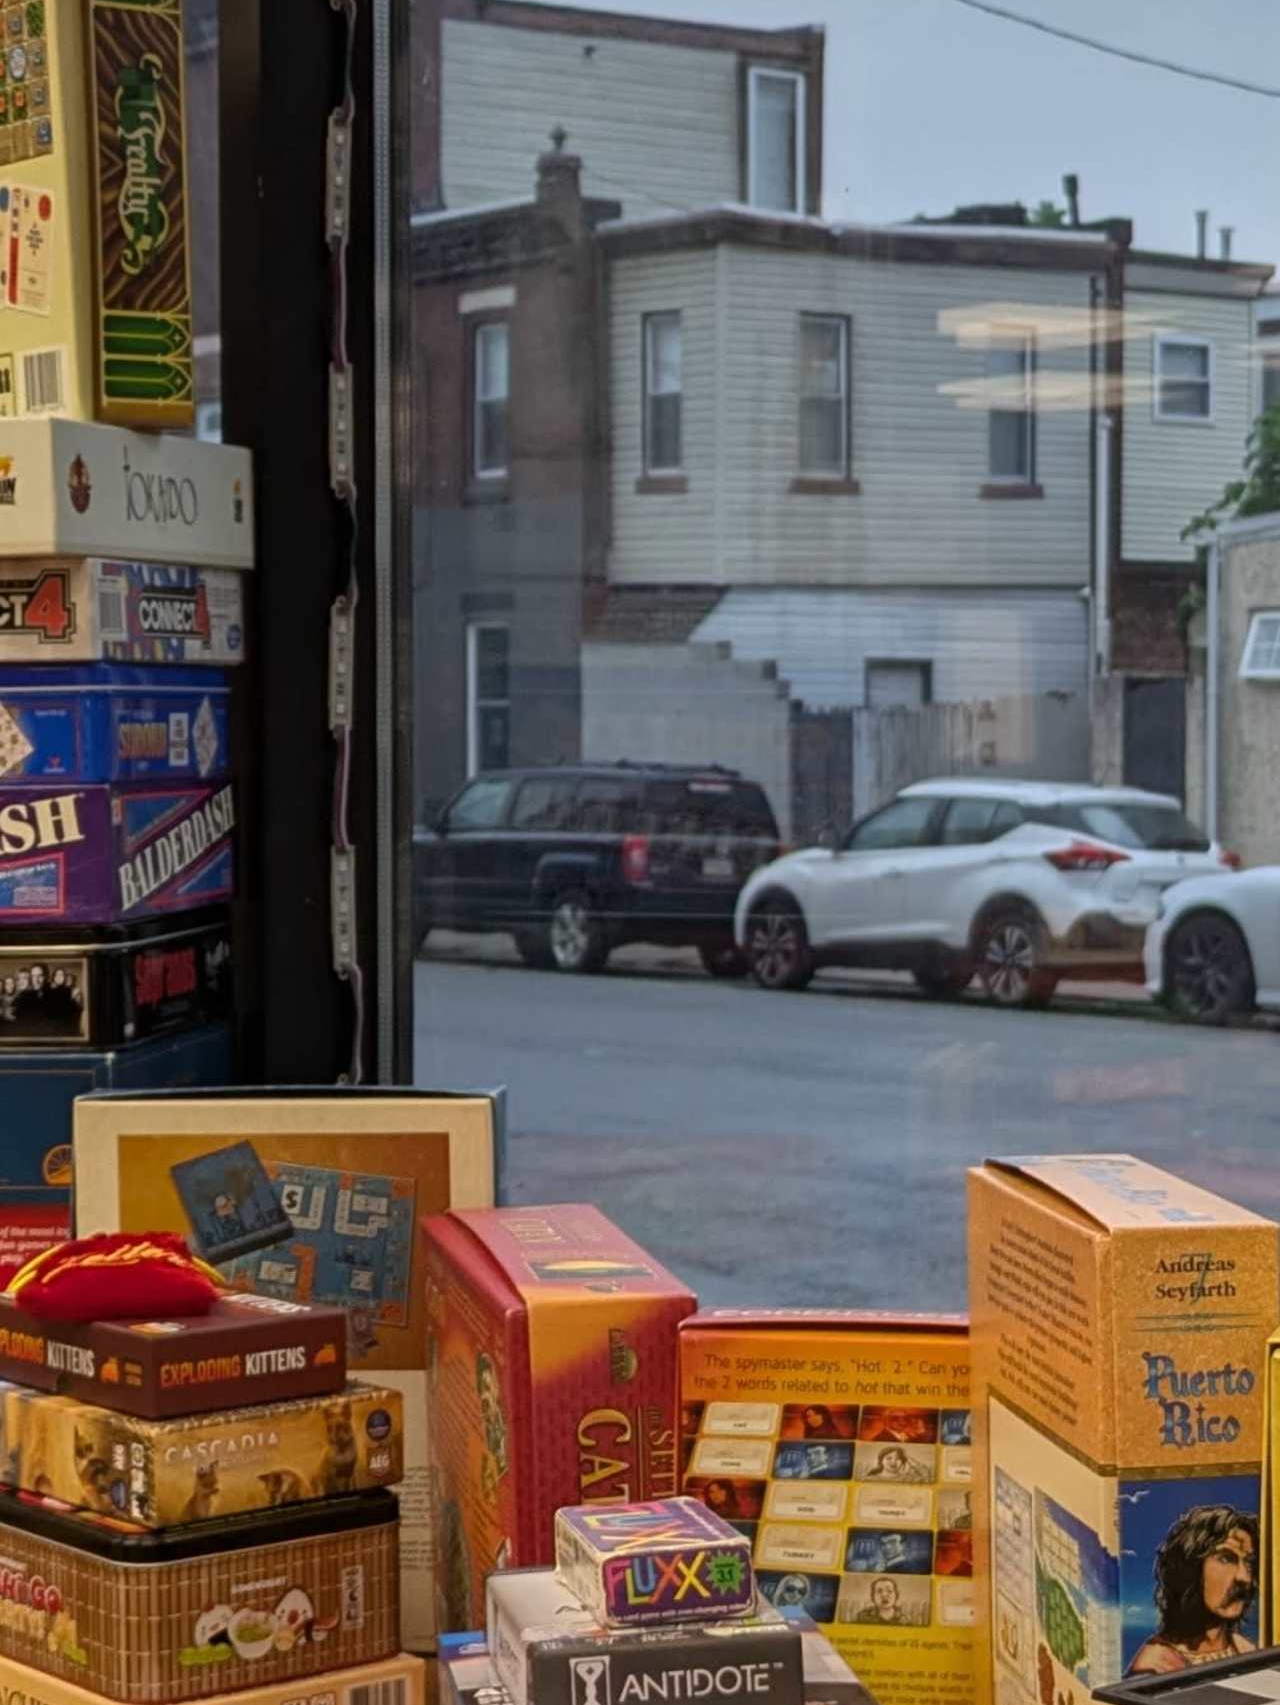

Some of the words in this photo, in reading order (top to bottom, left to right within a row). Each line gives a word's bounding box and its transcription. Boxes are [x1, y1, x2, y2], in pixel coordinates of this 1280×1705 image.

[24, 575, 68, 636] 4
[138, 599, 194, 633] CONNECT
[118, 784, 236, 912] BALDERDASH
[1155, 1257, 1236, 1274] Andreas
[1155, 1282, 1237, 1300] Seyfarth
[46, 1345, 95, 1378] KITTENS
[160, 1354, 241, 1388] EXPLODING
[244, 1345, 307, 1377] KITTENS
[704, 1354, 730, 1369] The
[735, 1356, 807, 1374] spymaster
[918, 1361, 946, 1375] Can
[1141, 1351, 1256, 1400] Puerto
[736, 1377, 778, 1393] words
[782, 1378, 829, 1394] related
[834, 1379, 848, 1394] to
[854, 1379, 877, 1394] hot
[882, 1380, 910, 1395] that
[916, 1381, 941, 1396] win
[946, 1382, 970, 1398] the
[1158, 1397, 1242, 1449] Rico
[164, 1429, 280, 1466] CASCADIA
[369, 1454, 392, 1471] AEG
[28, 1574, 64, 1615] GO
[604, 1550, 712, 1608] FLUXX
[619, 1662, 772, 1703] ANTIDOTE
